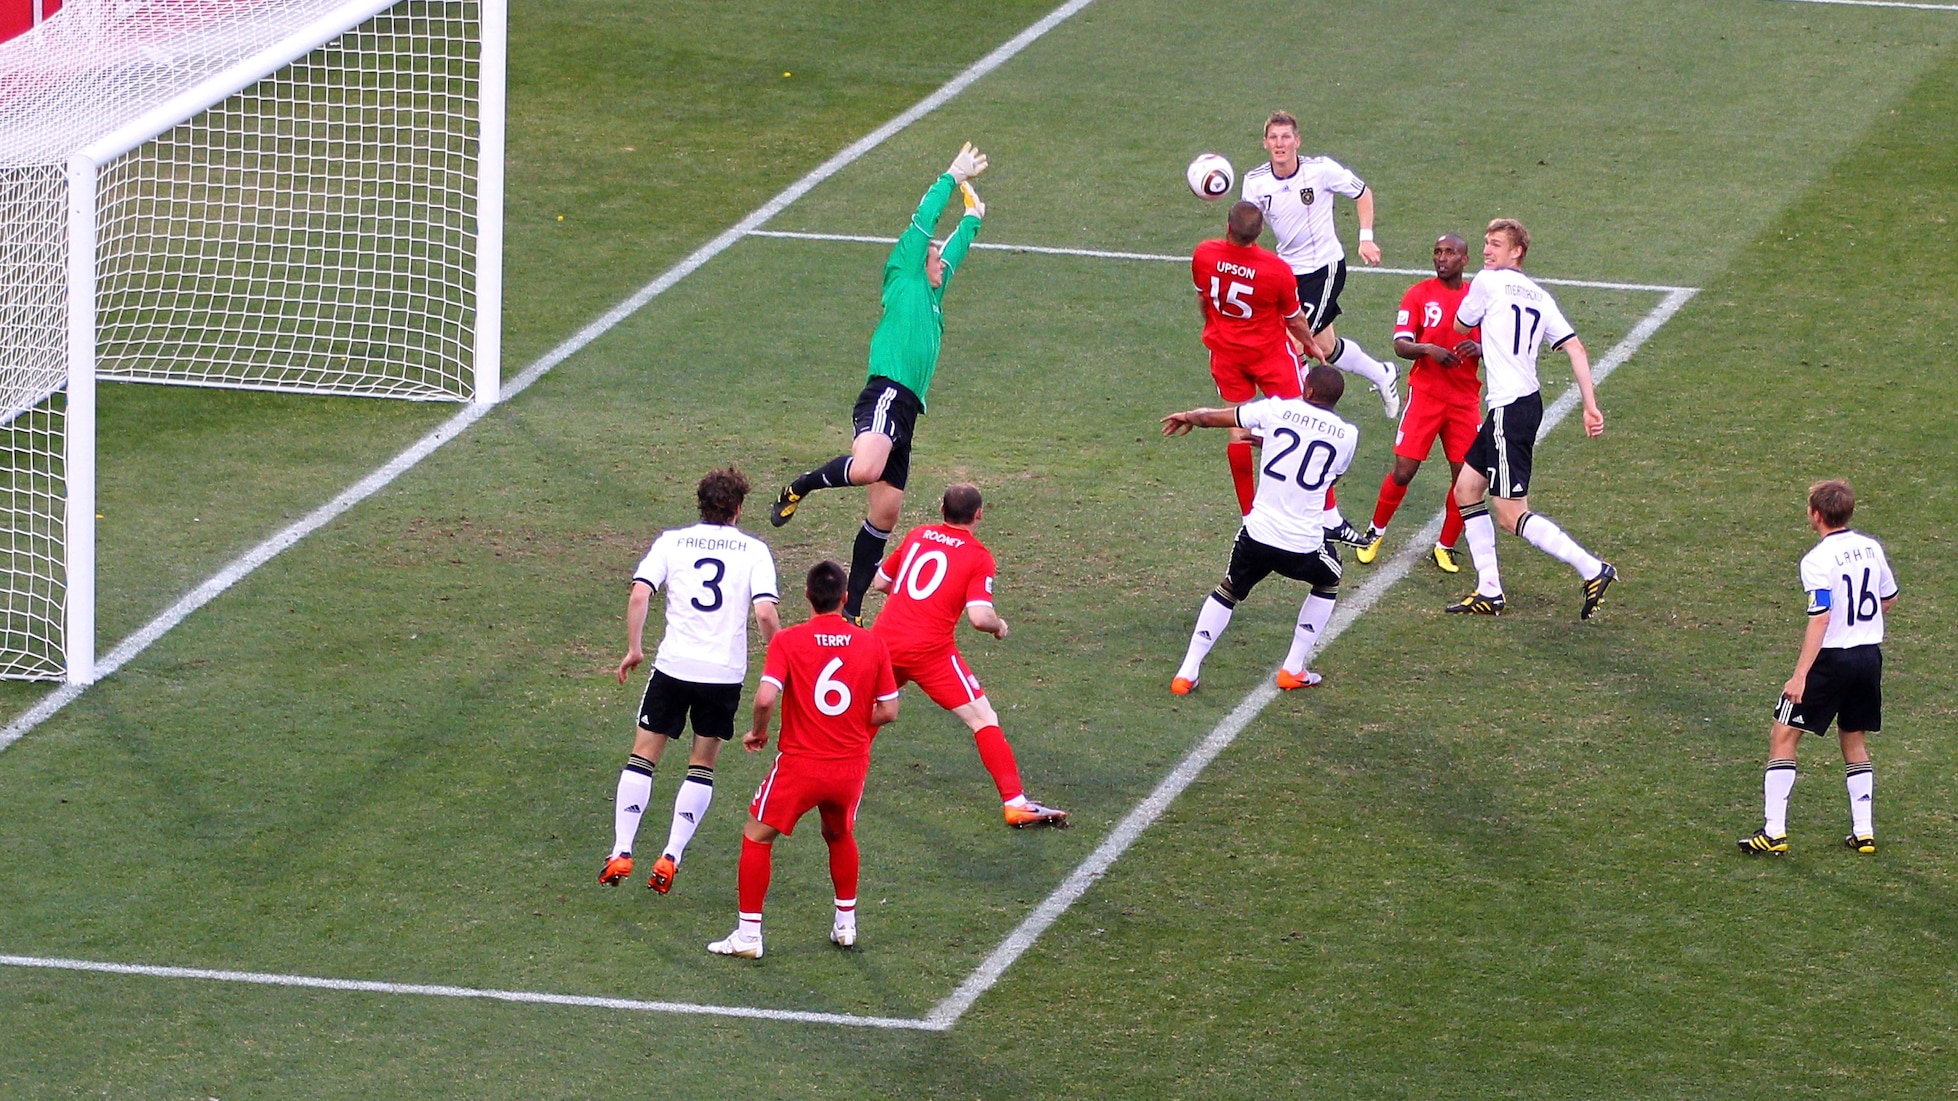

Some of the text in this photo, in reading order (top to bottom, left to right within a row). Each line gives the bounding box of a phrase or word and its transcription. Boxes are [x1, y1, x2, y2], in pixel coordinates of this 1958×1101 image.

[1263, 194, 1272, 211] 7
[1216, 260, 1256, 280] UPSON
[1210, 275, 1253, 320] 15
[1303, 301, 1315, 319] 7
[1422, 305, 1443, 328] 19
[1511, 303, 1541, 356] 17
[1282, 410, 1345, 439] BOATENG
[1263, 427, 1337, 491] 20
[676, 537, 747, 552] FRIEDRICH
[922, 529, 966, 548] ROONEY
[1834, 546, 1875, 567] LAHM
[893, 542, 948, 601] 10
[690, 557, 726, 613] 3
[1841, 567, 1878, 627] 16
[813, 633, 852, 647] TERRY
[813, 656, 852, 717] 6
